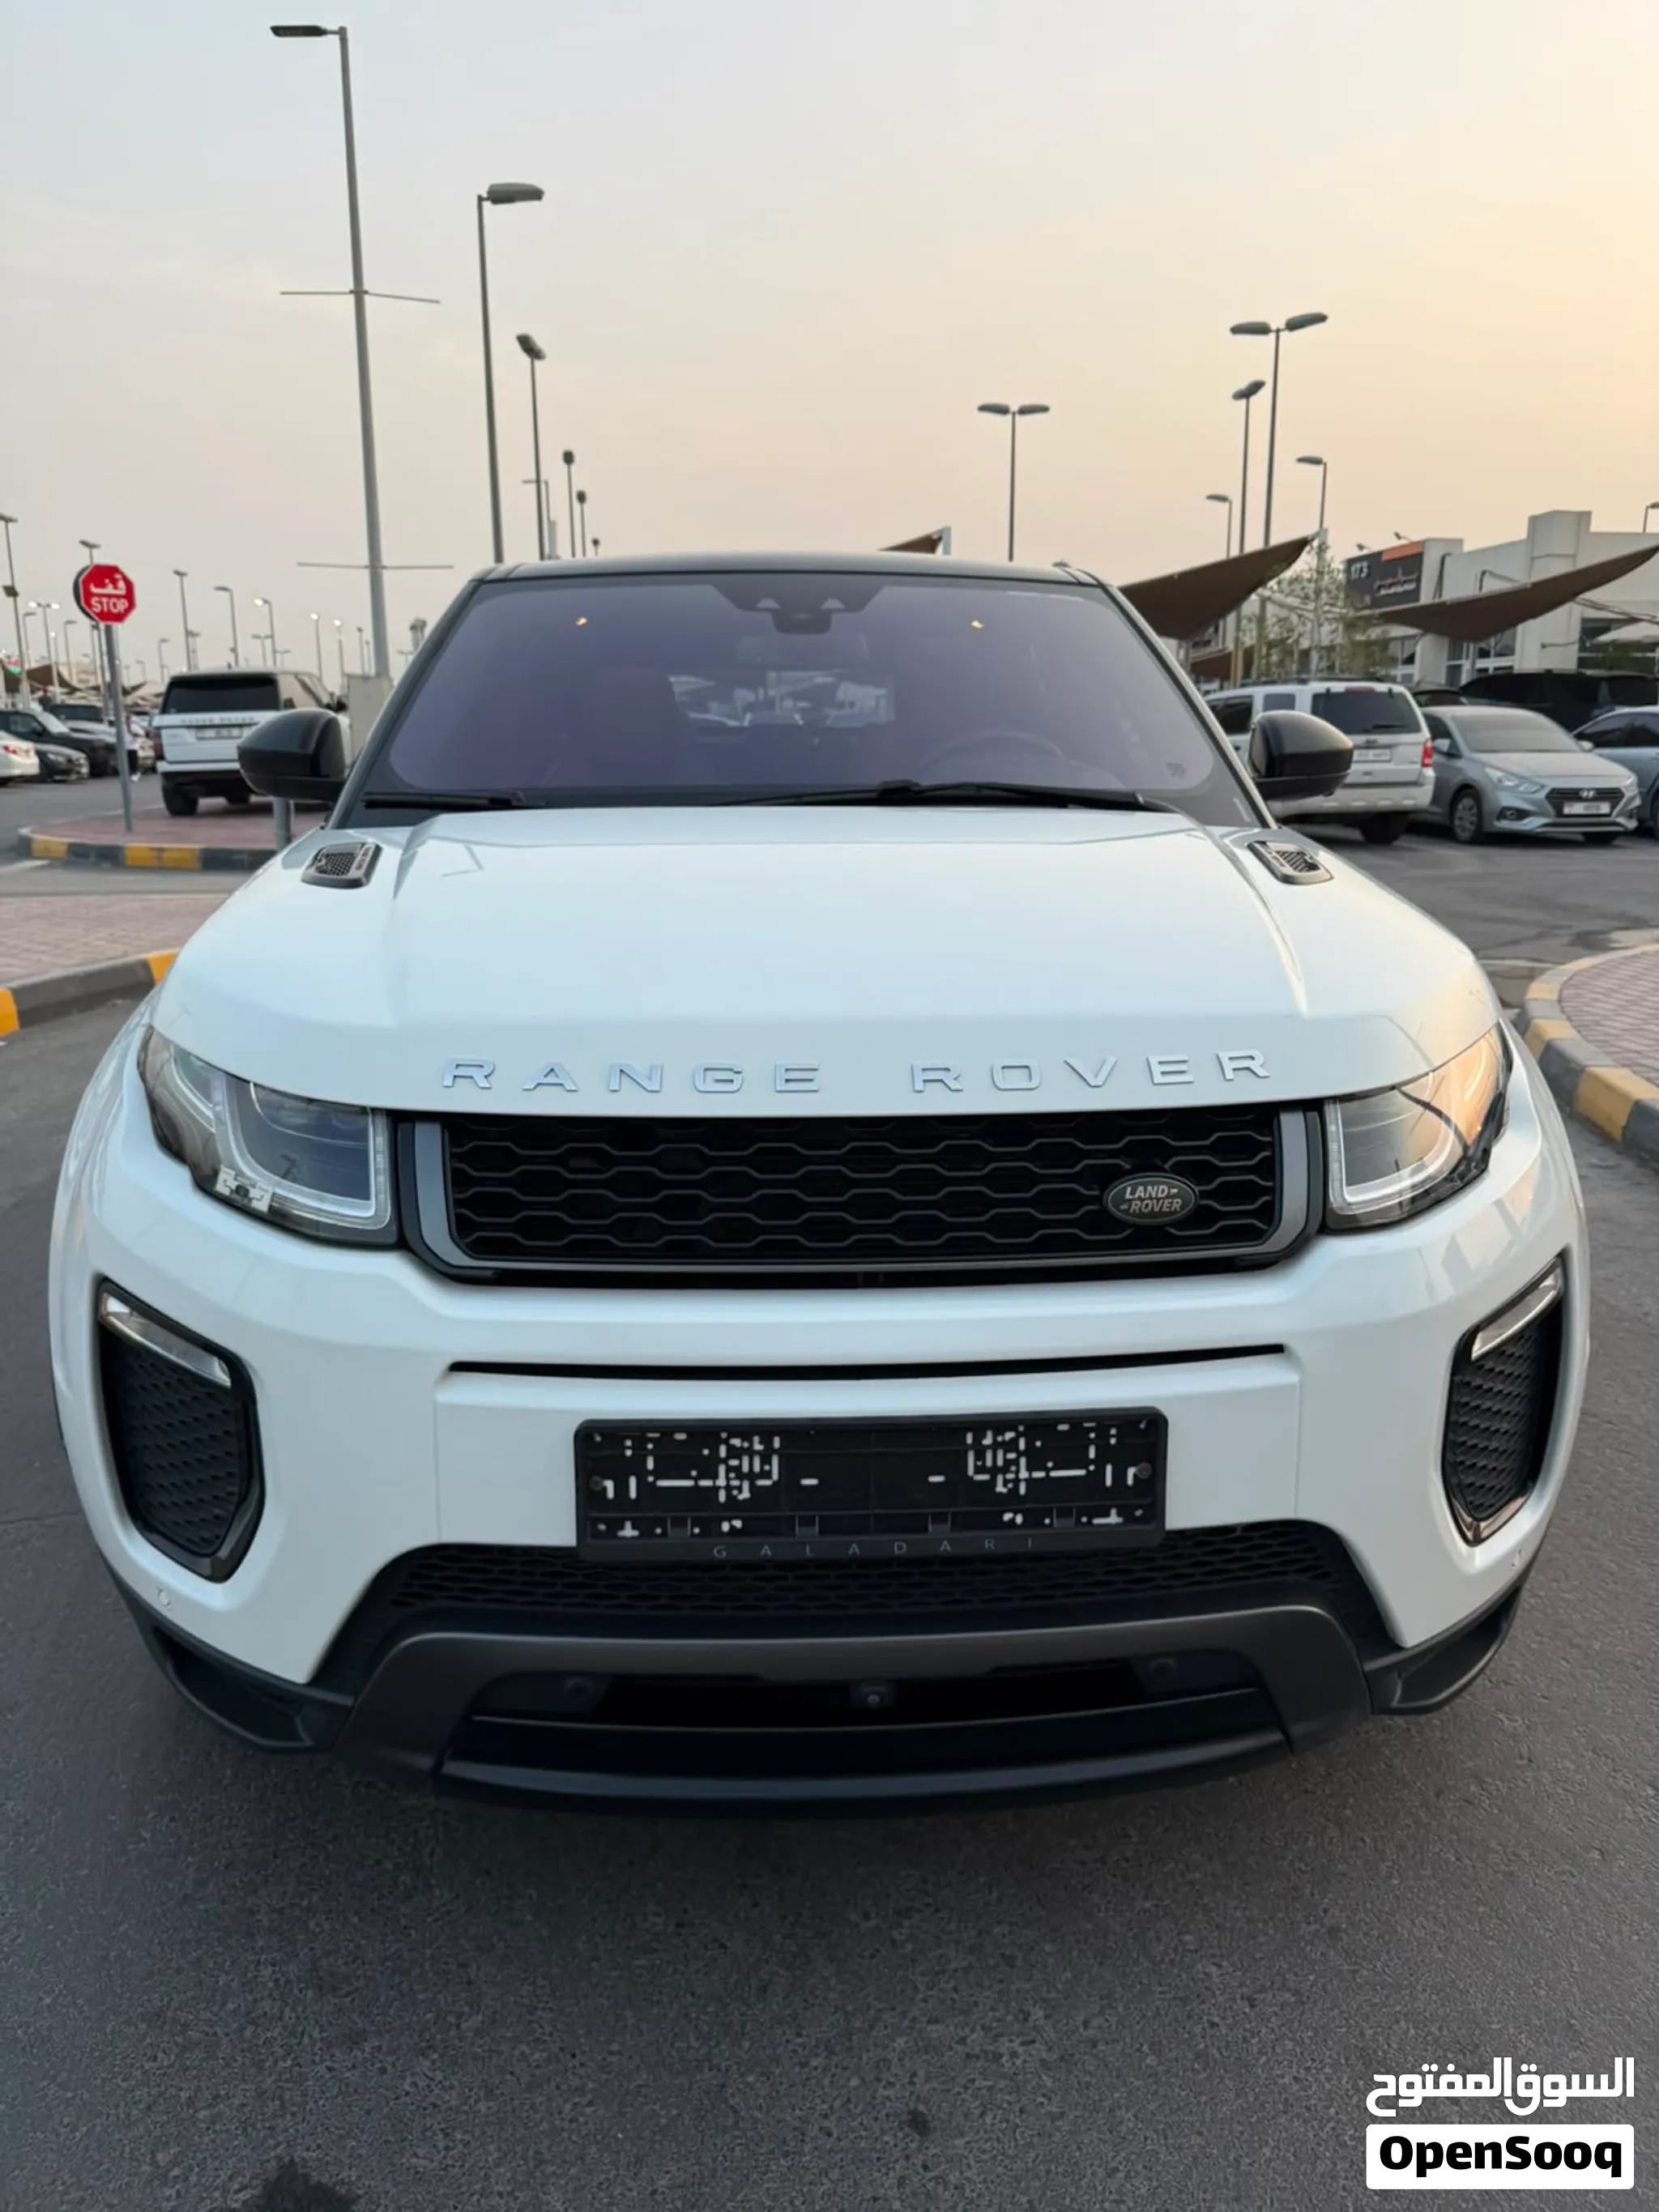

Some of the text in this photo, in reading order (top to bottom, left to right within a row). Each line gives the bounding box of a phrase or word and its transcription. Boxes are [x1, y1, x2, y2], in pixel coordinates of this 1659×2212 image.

[90, 573, 126, 595] قف
[91, 597, 129, 613] STOP
[442, 1049, 1271, 1093] RANGE ROVER
[1124, 1184, 1168, 1200] LAND
[1129, 1198, 1183, 1213] ROVER
[714, 1538, 1033, 1558] GALADARI
